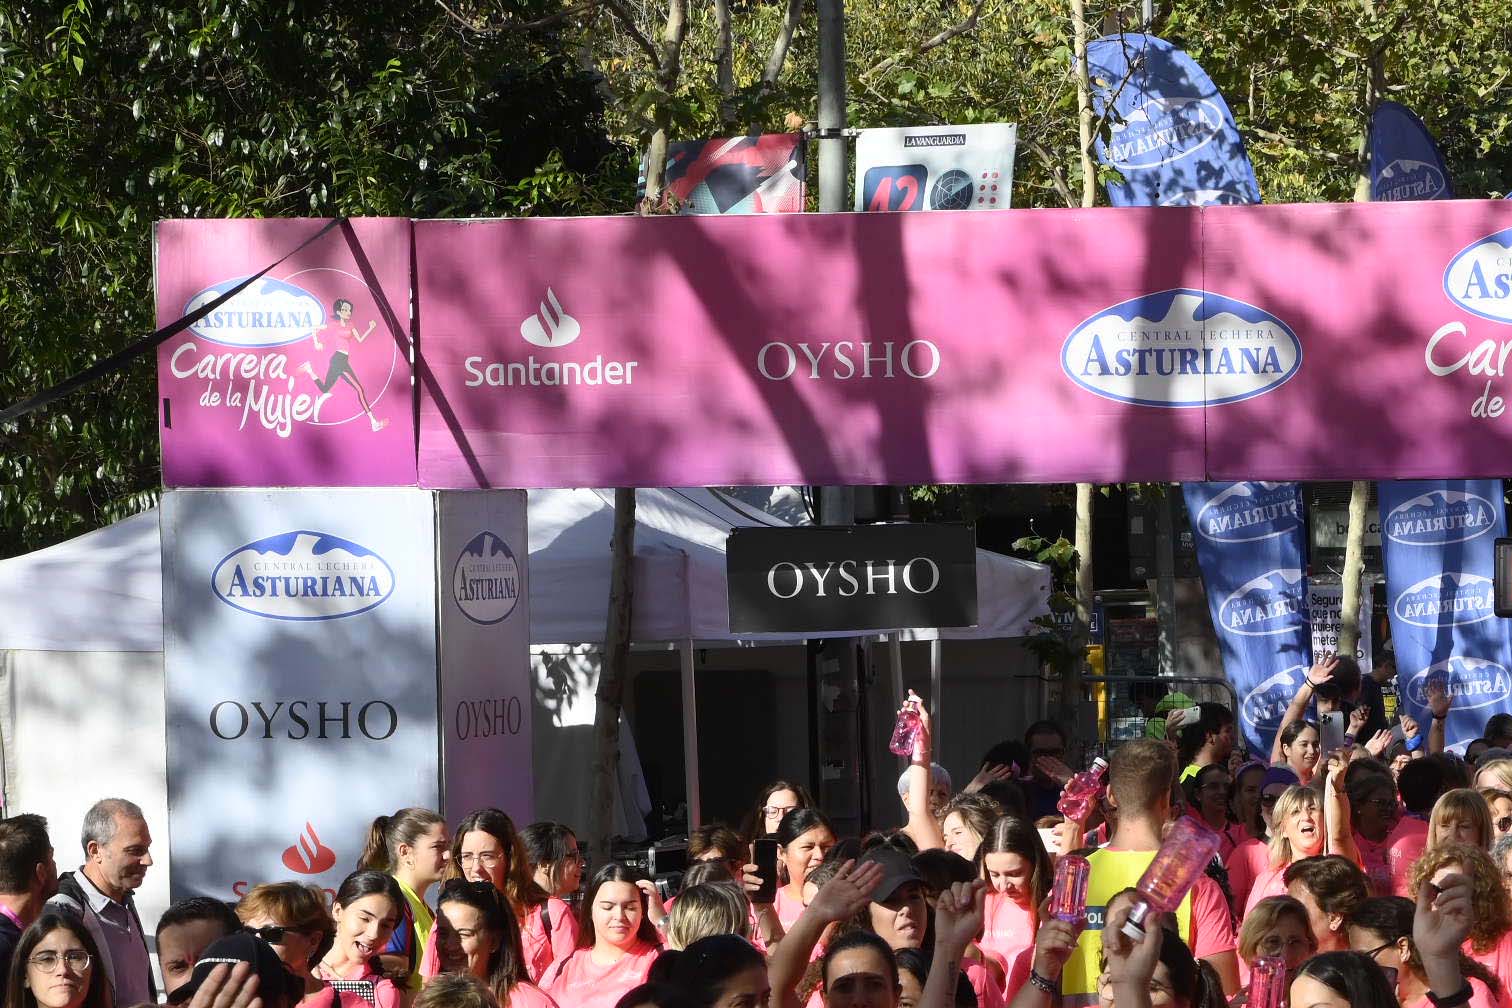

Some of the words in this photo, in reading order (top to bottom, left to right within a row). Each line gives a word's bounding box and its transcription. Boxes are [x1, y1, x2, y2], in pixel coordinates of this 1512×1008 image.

[193, 302, 313, 329] ASTURIANA
[1117, 330, 1192, 342] CENTRAL
[1201, 329, 1276, 341] LECHERA
[170, 342, 288, 379] Carrera
[464, 356, 639, 387] Santander
[757, 340, 941, 381] OYSHO
[1081, 334, 1284, 376] ASTURIANA
[199, 381, 221, 407] de
[226, 381, 242, 407] la
[239, 378, 333, 437] Mujer
[1471, 380, 1505, 418] de
[226, 564, 384, 597] ASTURIANA
[459, 565, 518, 600] ASTURIANA
[767, 557, 940, 599] OYSHO
[1312, 610, 1328, 623] que
[209, 700, 398, 740] OYSHO
[455, 696, 521, 741] OYSHO
[1086, 912, 1104, 923] OL
